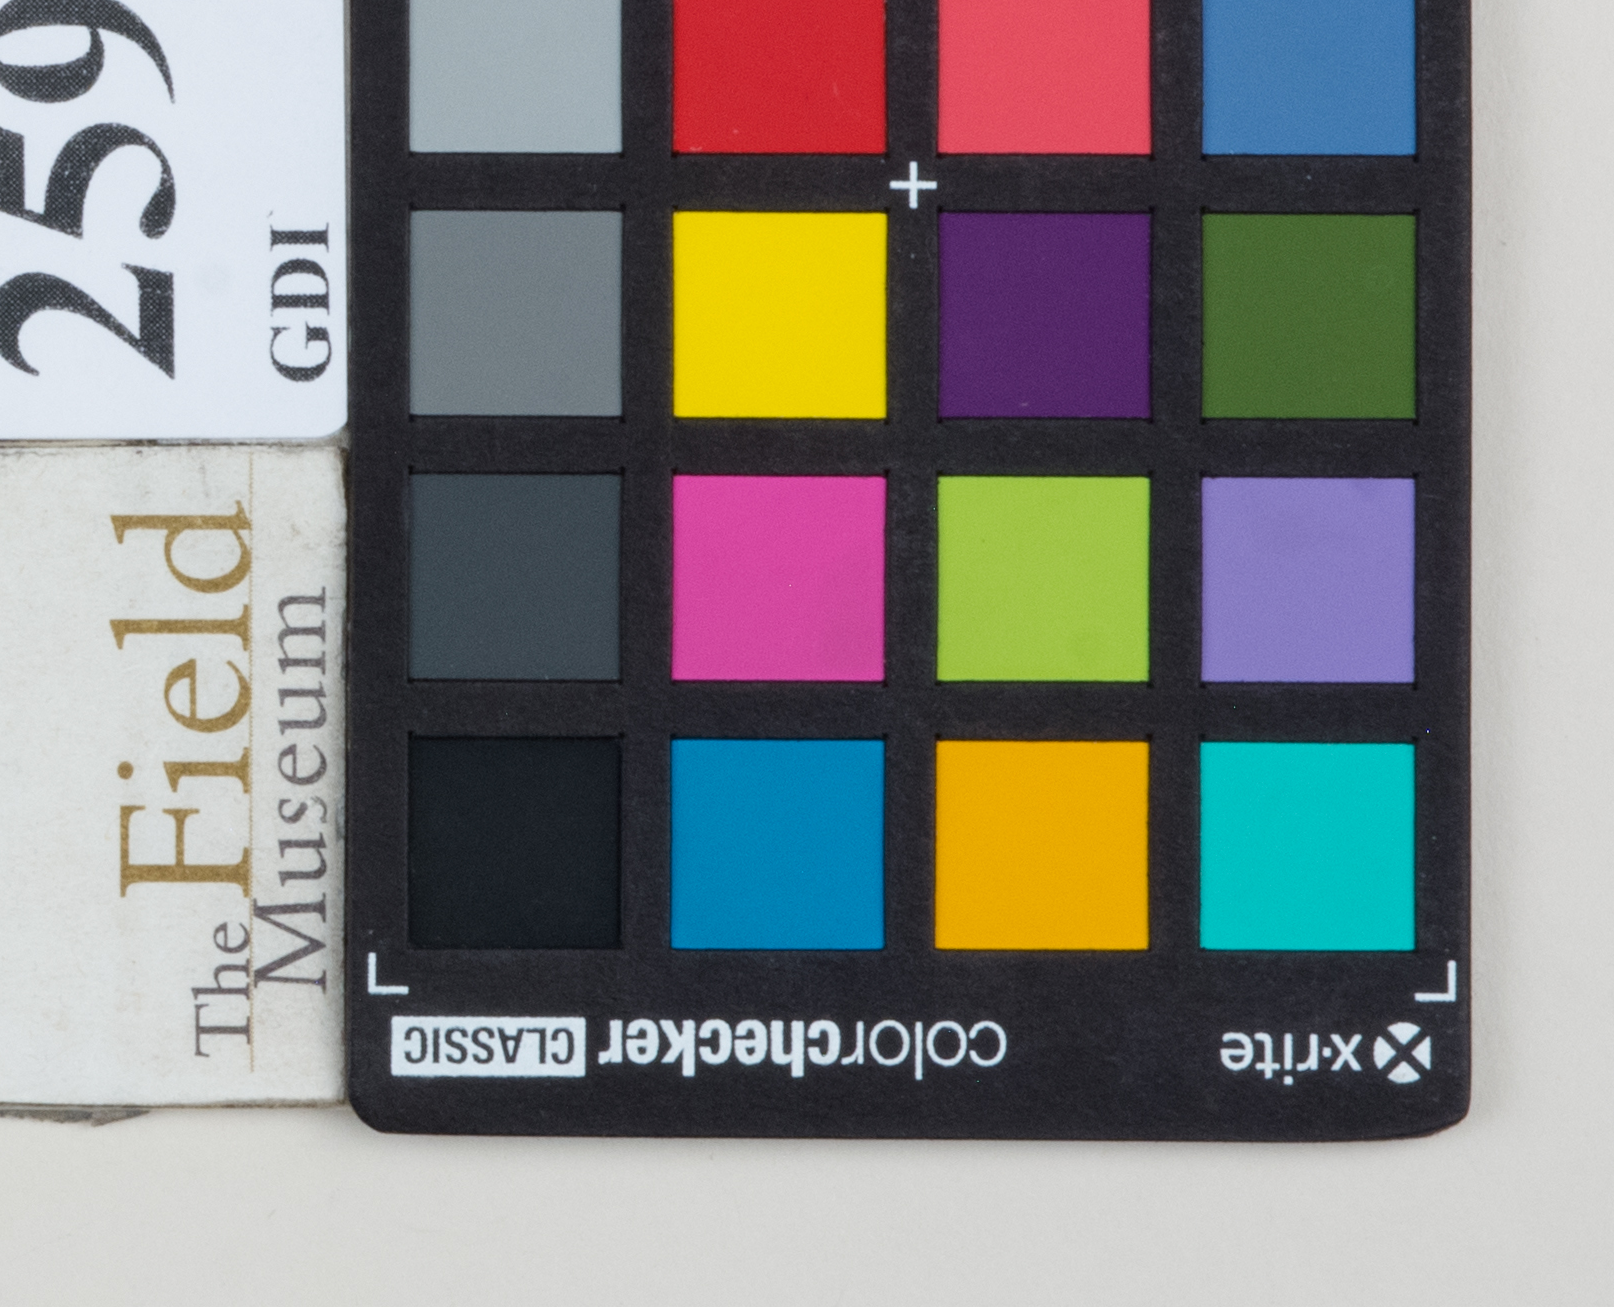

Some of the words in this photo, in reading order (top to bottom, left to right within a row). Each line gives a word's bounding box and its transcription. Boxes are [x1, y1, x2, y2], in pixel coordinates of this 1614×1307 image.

[270, 224, 333, 382] GDI
[110, 500, 252, 899] Field
[254, 587, 329, 994] Museum
[191, 921, 251, 1058] The
[404, 1026, 575, 1066] CLASSIC
[597, 1018, 1007, 1081] colorchecker
